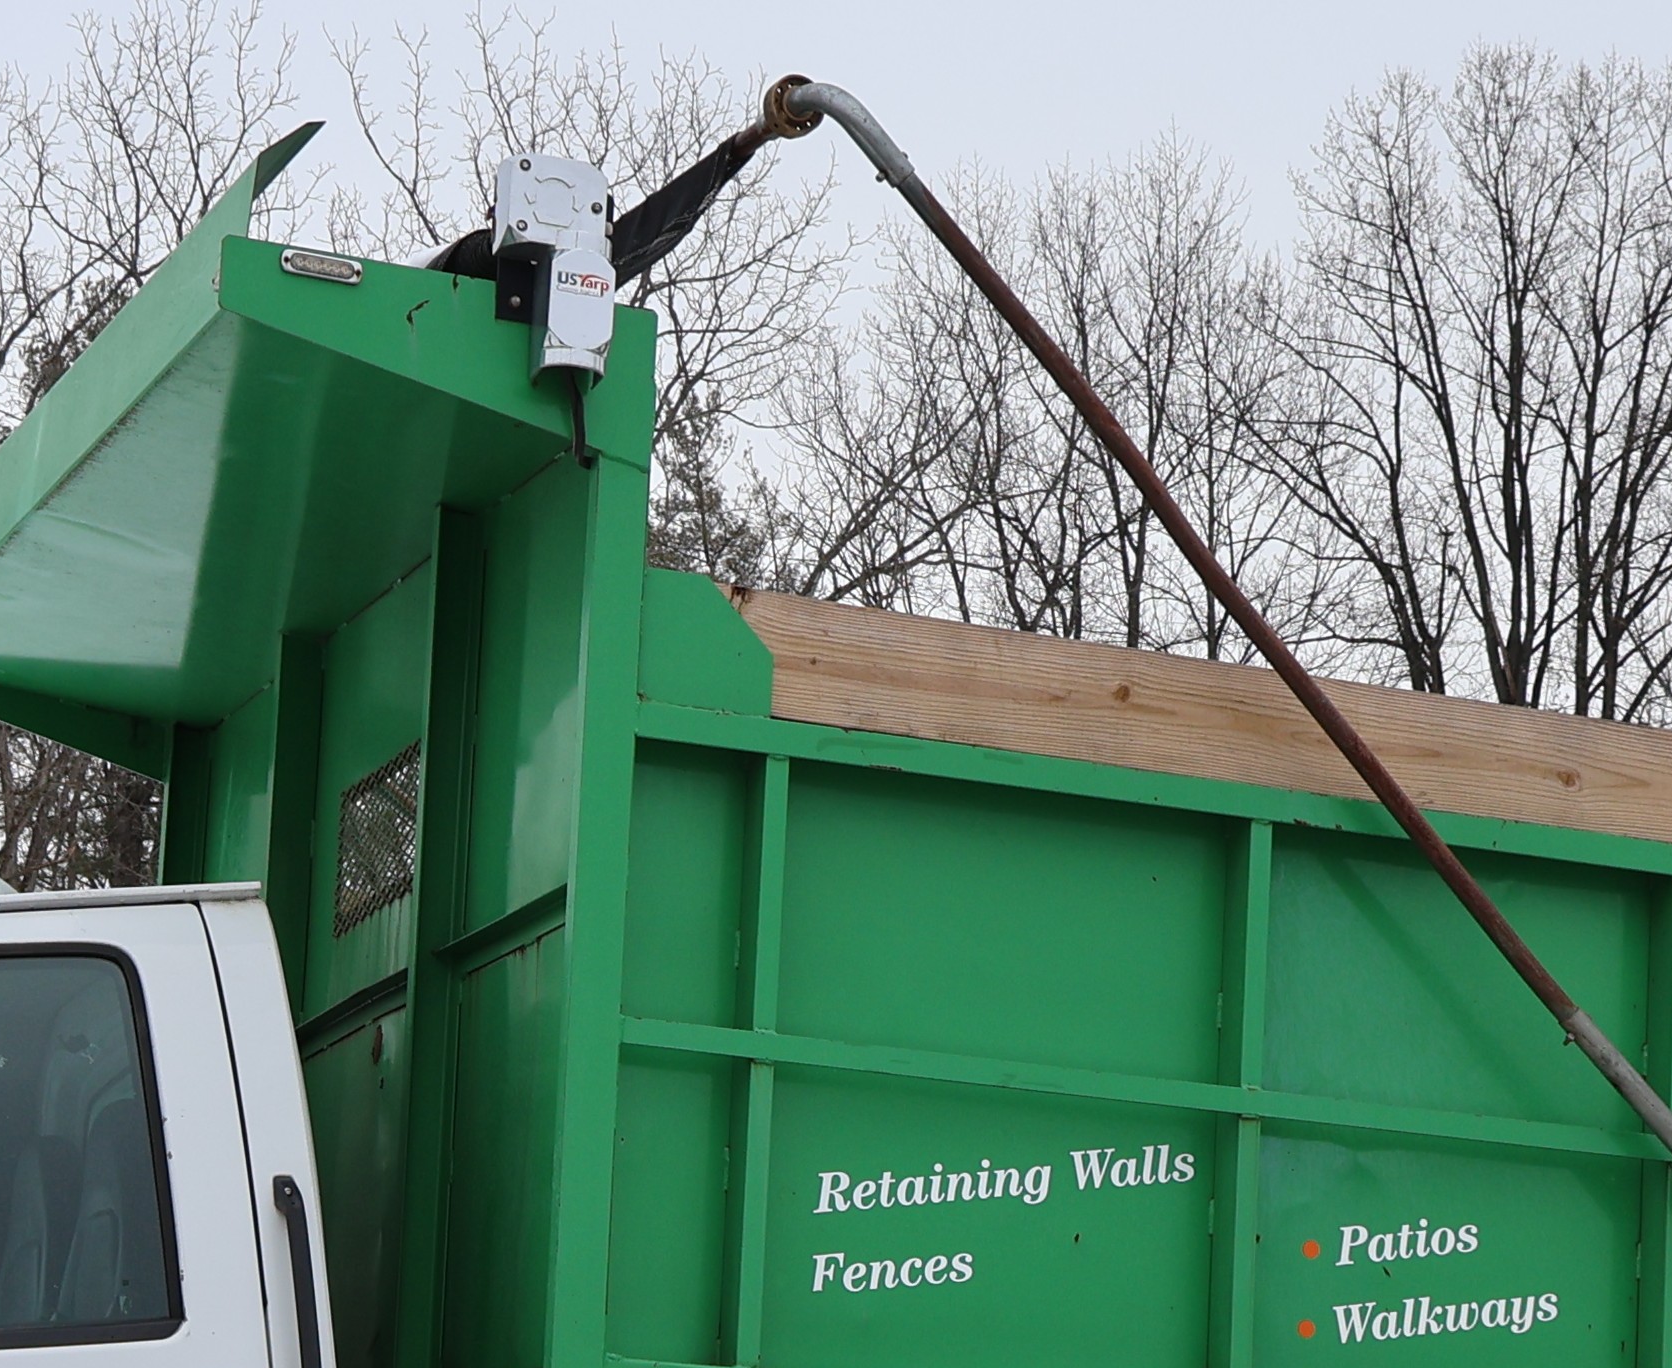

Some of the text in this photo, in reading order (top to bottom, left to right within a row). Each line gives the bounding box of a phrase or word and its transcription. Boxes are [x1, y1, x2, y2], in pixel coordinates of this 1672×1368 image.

[812, 1144, 1195, 1214] Retaining Walls
[1335, 1218, 1479, 1267] Patios
[812, 1252, 973, 1292] Fences
[1332, 1293, 1558, 1344] Walkways
